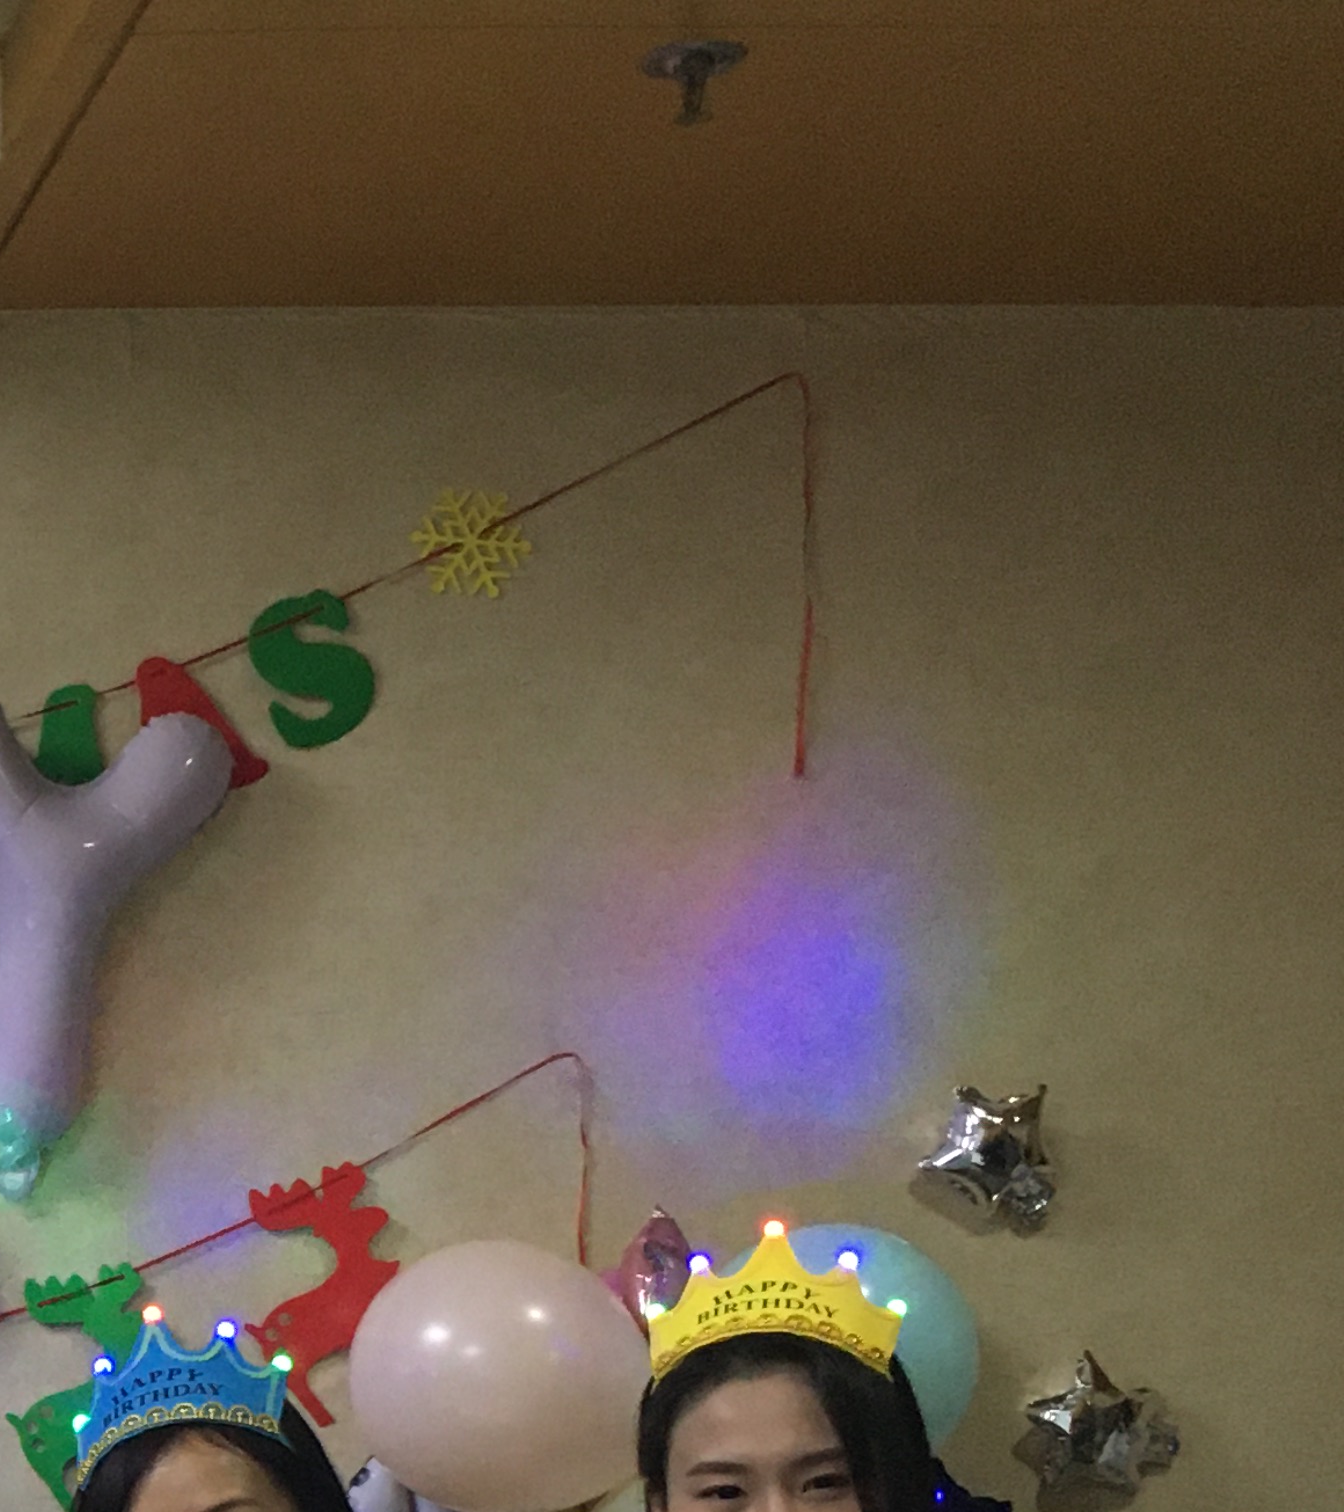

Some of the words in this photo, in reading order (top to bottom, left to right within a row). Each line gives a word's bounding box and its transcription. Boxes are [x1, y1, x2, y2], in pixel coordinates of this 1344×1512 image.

[712, 1280, 821, 1304] HAPPY
[697, 1298, 840, 1325] BIRTHDAY
[111, 1367, 205, 1406] HAPPY
[102, 1383, 225, 1428] BIRTHDAY
